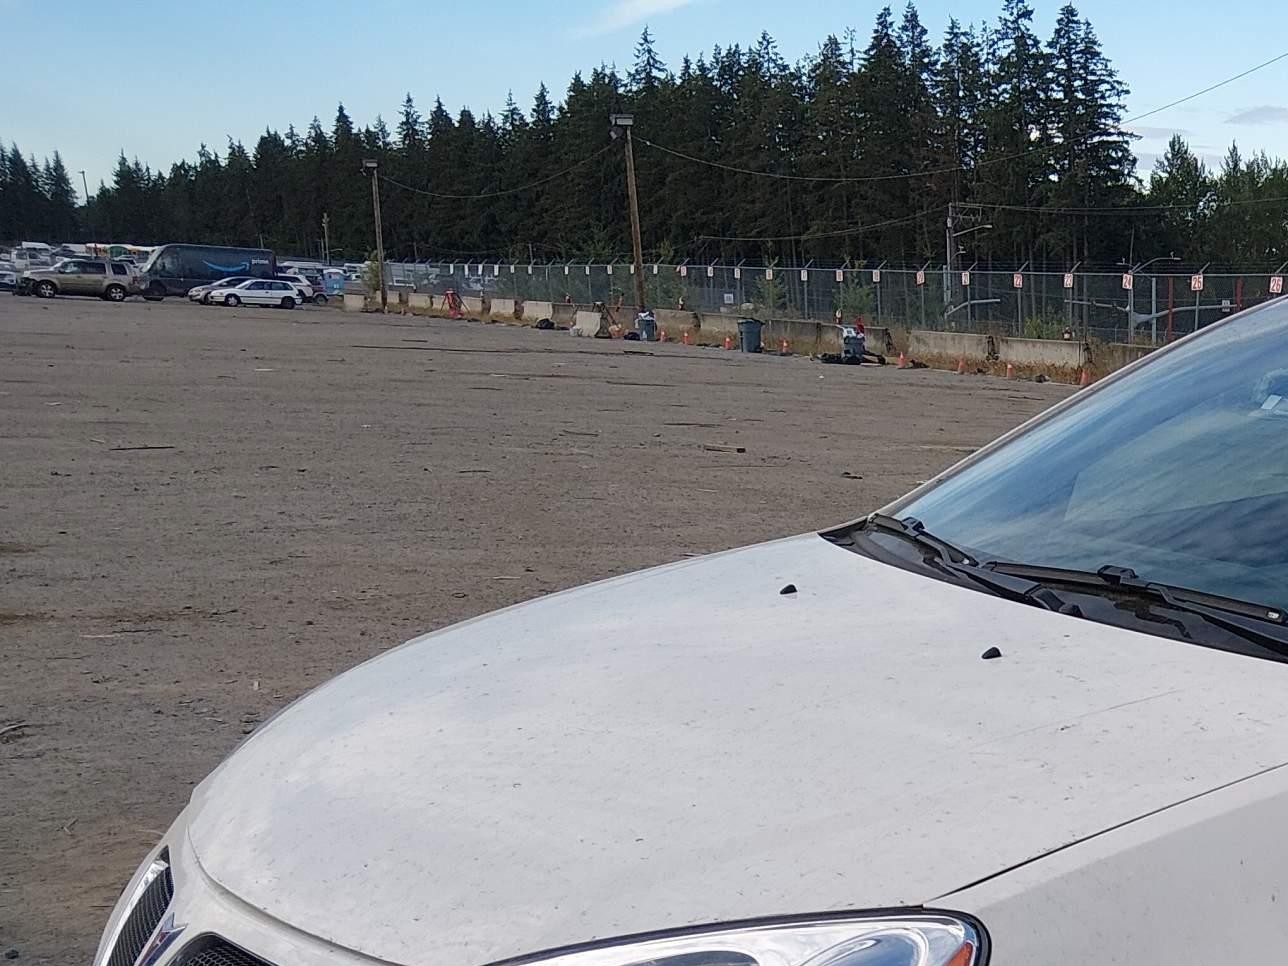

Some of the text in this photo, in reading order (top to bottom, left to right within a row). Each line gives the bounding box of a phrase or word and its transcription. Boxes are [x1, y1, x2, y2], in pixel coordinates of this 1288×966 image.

[1124, 275, 1132, 288] 24
[1192, 275, 1202, 289] 25
[1271, 278, 1281, 292] 26
